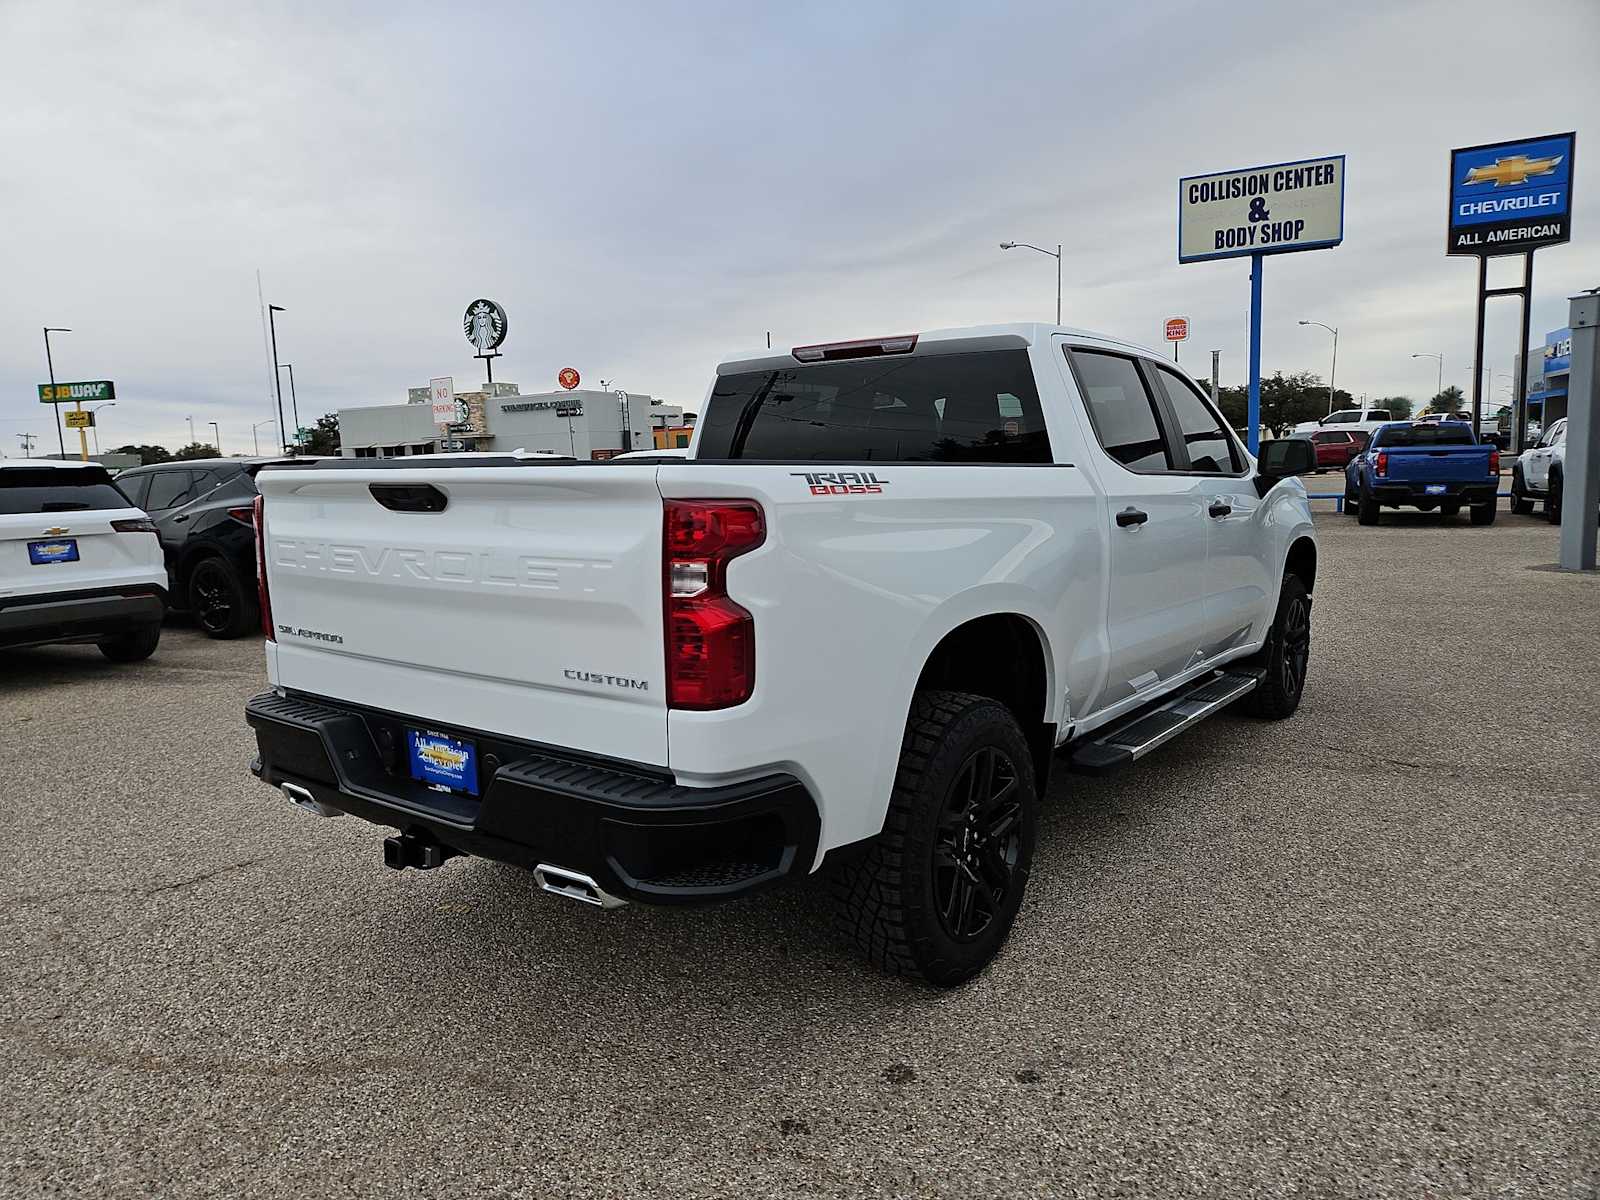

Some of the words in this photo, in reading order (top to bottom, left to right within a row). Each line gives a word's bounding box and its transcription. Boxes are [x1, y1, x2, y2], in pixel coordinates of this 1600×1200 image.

[1189, 174, 1269, 204] COLLISION
[1273, 164, 1334, 192] CENTER
[1248, 197, 1269, 223] &
[1459, 192, 1560, 216] CHEVROLET
[1215, 226, 1256, 250] BODY
[1260, 219, 1304, 244] SHOP
[1457, 232, 1482, 246] ALL
[1487, 223, 1561, 242] AMERICAN
[1166, 329, 1187, 337] KING
[42, 384, 105, 399] SUBWAY
[436, 388, 448, 399] NO
[432, 404, 455, 414] PARKING
[790, 472, 889, 484] TRAIL
[809, 485, 882, 496] BOSS
[274, 539, 613, 592] CHEVROLET
[564, 669, 648, 690] CUSTOM
[414, 737, 426, 748] All
[430, 740, 469, 760] American
